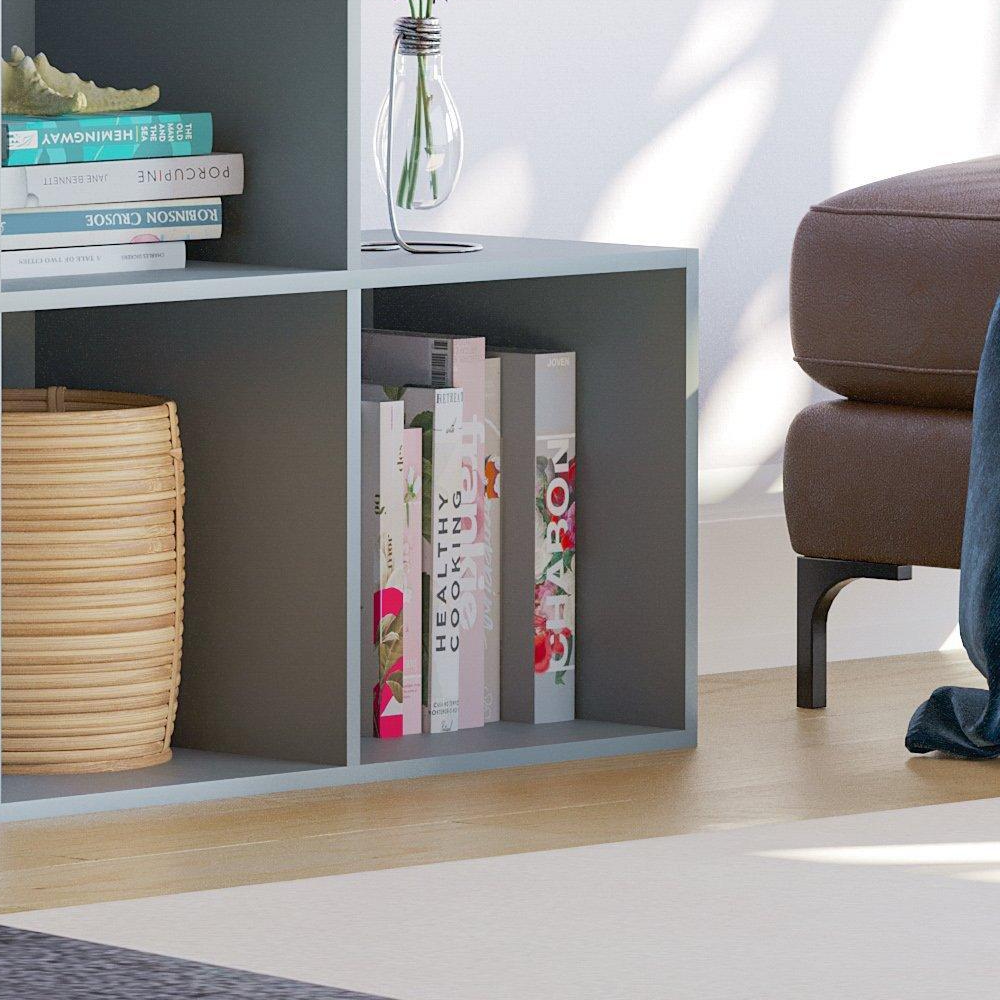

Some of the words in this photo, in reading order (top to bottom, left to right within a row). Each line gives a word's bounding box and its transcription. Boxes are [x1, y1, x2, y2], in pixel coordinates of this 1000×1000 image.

[41, 129, 133, 145] HEMINGWAY
[140, 125, 149, 142] SEA
[149, 124, 157, 142] THE
[158, 123, 166, 142] AND
[167, 122, 175, 142] MAN
[43, 175, 85, 186] BENNETT
[87, 174, 108, 184] JANE
[137, 165, 231, 184] PORCUPINE
[85, 211, 142, 227] CRUSOE
[146, 208, 218, 224] ROBINSON
[546, 357, 570, 368] JOVEN
[546, 438, 570, 666] CHABON
[435, 492, 449, 653] HEALTHY
[450, 489, 462, 653] COOKING
